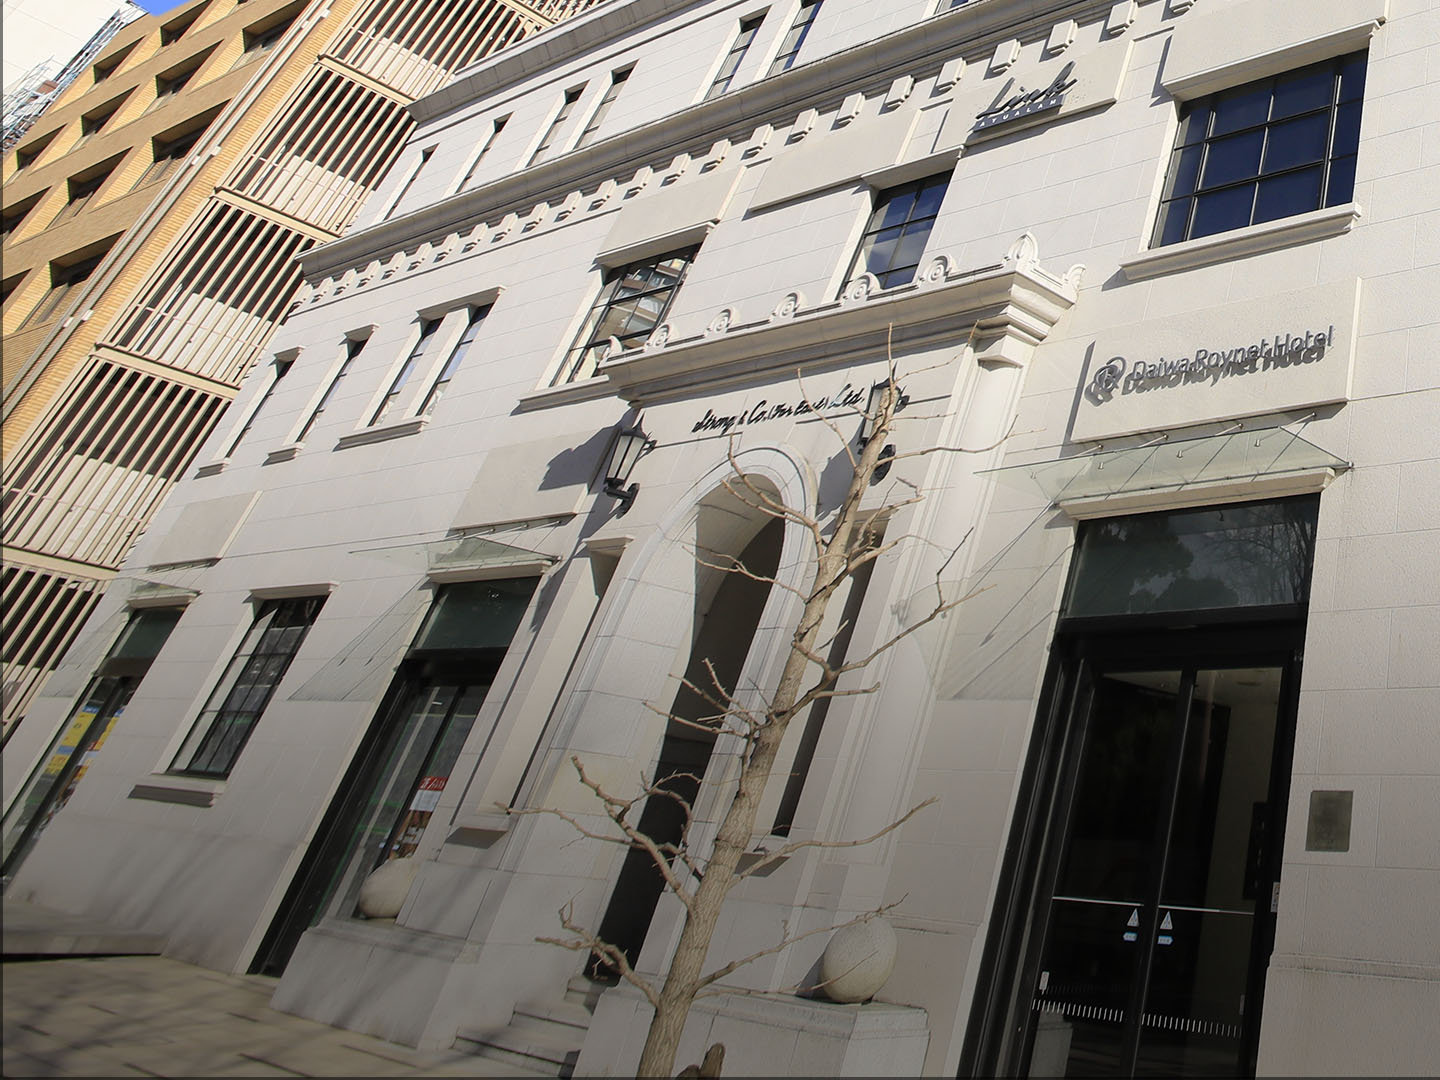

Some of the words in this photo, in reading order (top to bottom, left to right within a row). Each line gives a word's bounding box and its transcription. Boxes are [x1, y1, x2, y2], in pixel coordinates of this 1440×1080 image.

[1132, 357, 1192, 380] Daiwa
[1194, 338, 1269, 370] Roynet
[1273, 325, 1334, 357] Hotel
